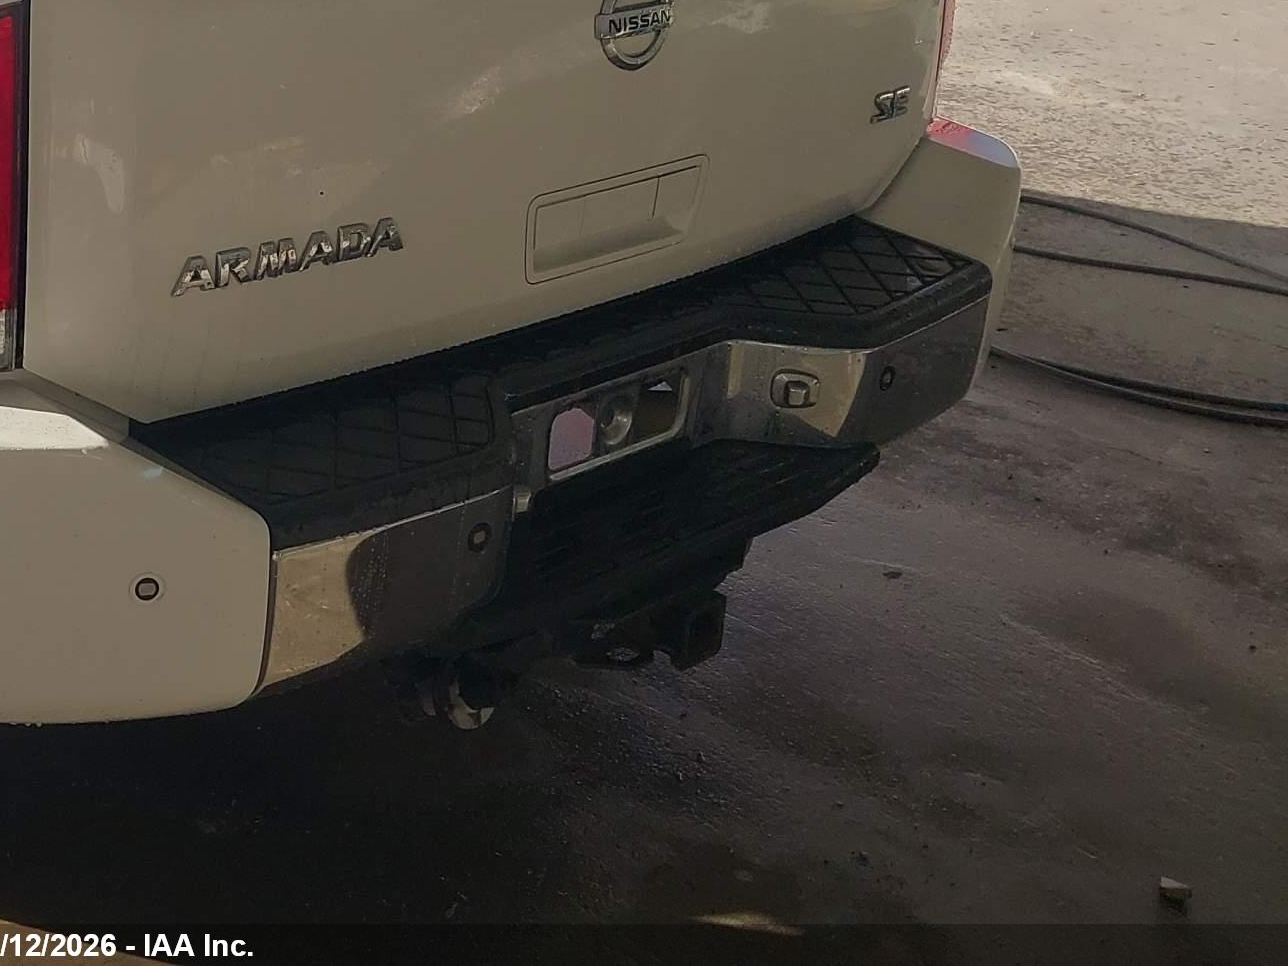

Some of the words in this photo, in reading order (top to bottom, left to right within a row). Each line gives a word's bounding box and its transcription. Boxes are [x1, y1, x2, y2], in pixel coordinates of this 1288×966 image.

[608, 9, 672, 34] NISSAN
[870, 85, 911, 124] SE
[170, 216, 404, 297] ARMADA
